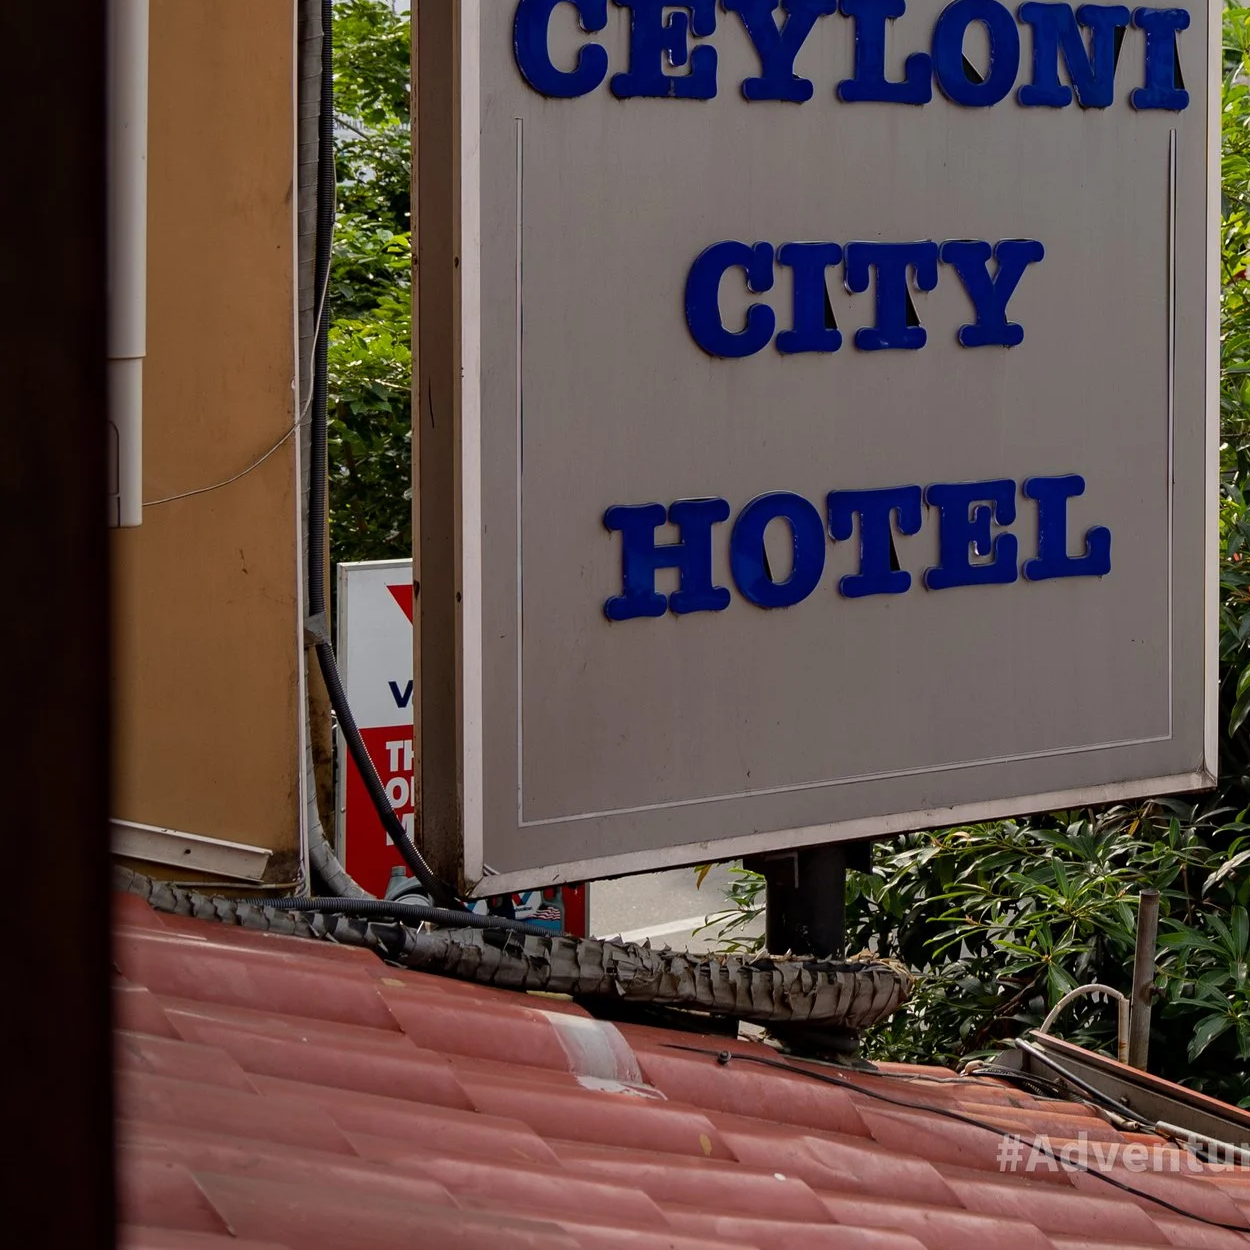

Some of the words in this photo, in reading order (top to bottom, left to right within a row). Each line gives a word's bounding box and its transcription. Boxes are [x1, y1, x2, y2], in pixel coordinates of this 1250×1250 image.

[685, 238, 1045, 359] CITY
[602, 473, 1112, 621] HOTEL
[388, 679, 414, 708] V
[386, 776, 414, 809] O
